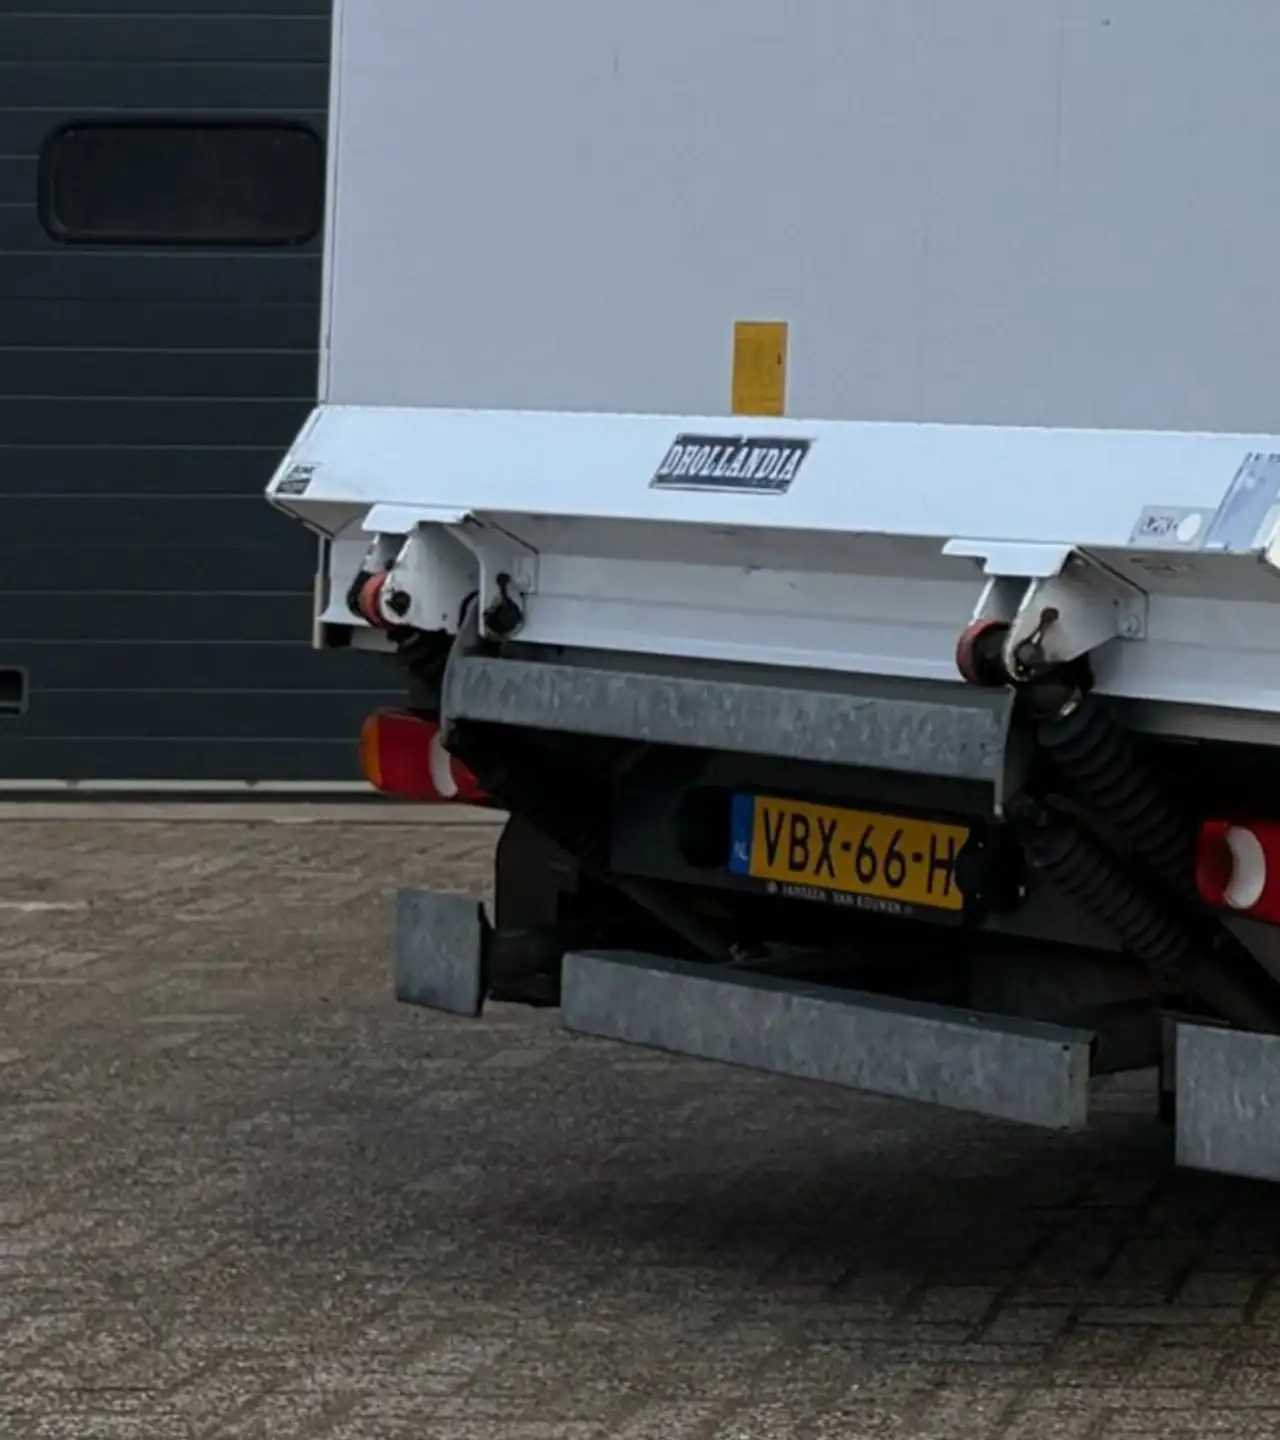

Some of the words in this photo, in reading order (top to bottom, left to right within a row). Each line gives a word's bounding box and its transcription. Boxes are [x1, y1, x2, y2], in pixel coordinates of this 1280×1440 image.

[657, 444, 803, 480] DHOLLANDIA
[733, 841, 748, 860] NL
[763, 807, 955, 897] VBX-66-H
